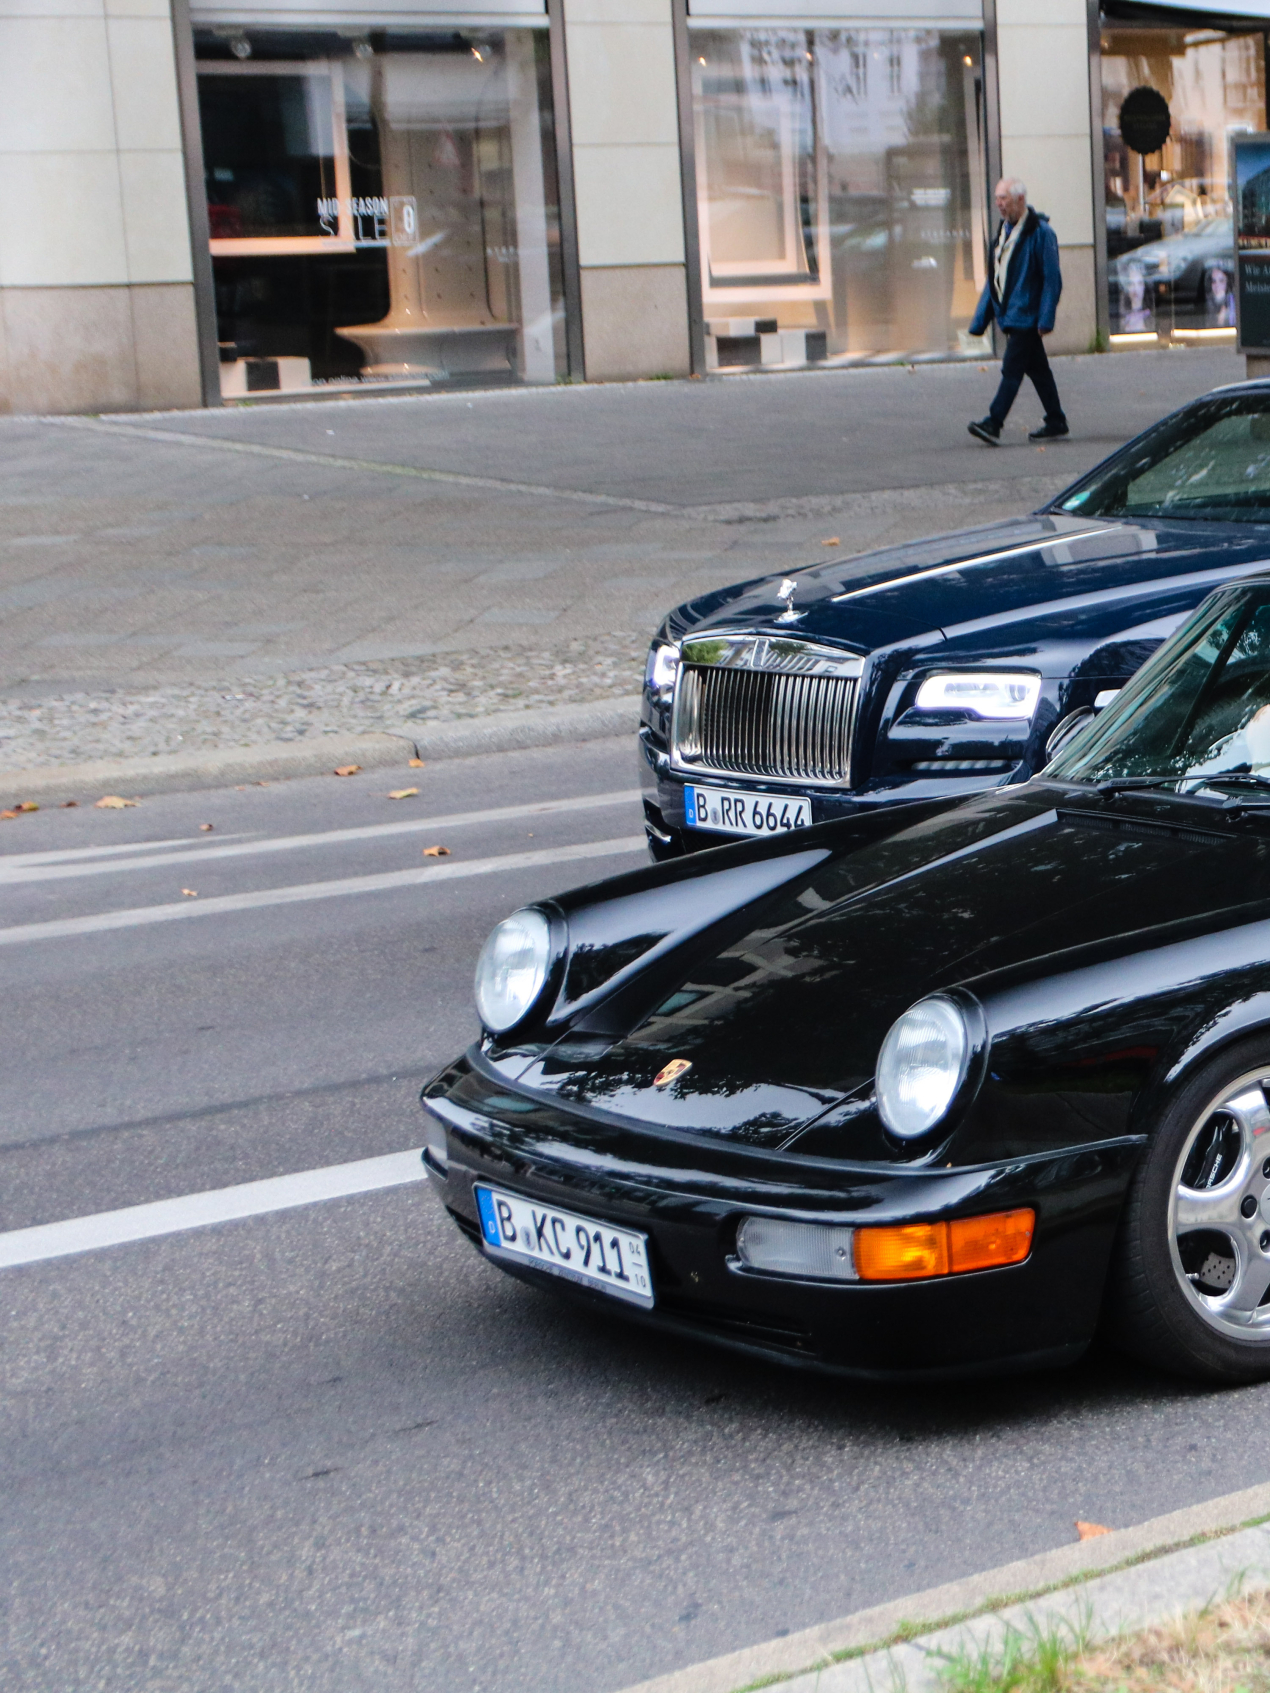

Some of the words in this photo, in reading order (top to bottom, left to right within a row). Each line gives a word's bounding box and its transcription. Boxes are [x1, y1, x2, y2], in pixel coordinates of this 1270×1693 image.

[1244, 264, 1261, 276] Wie
[696, 792, 708, 822] B
[721, 796, 748, 828] RR
[752, 800, 806, 831] 6644
[496, 1198, 517, 1242] B
[531, 1209, 572, 1261] KC
[575, 1224, 630, 1283] 911
